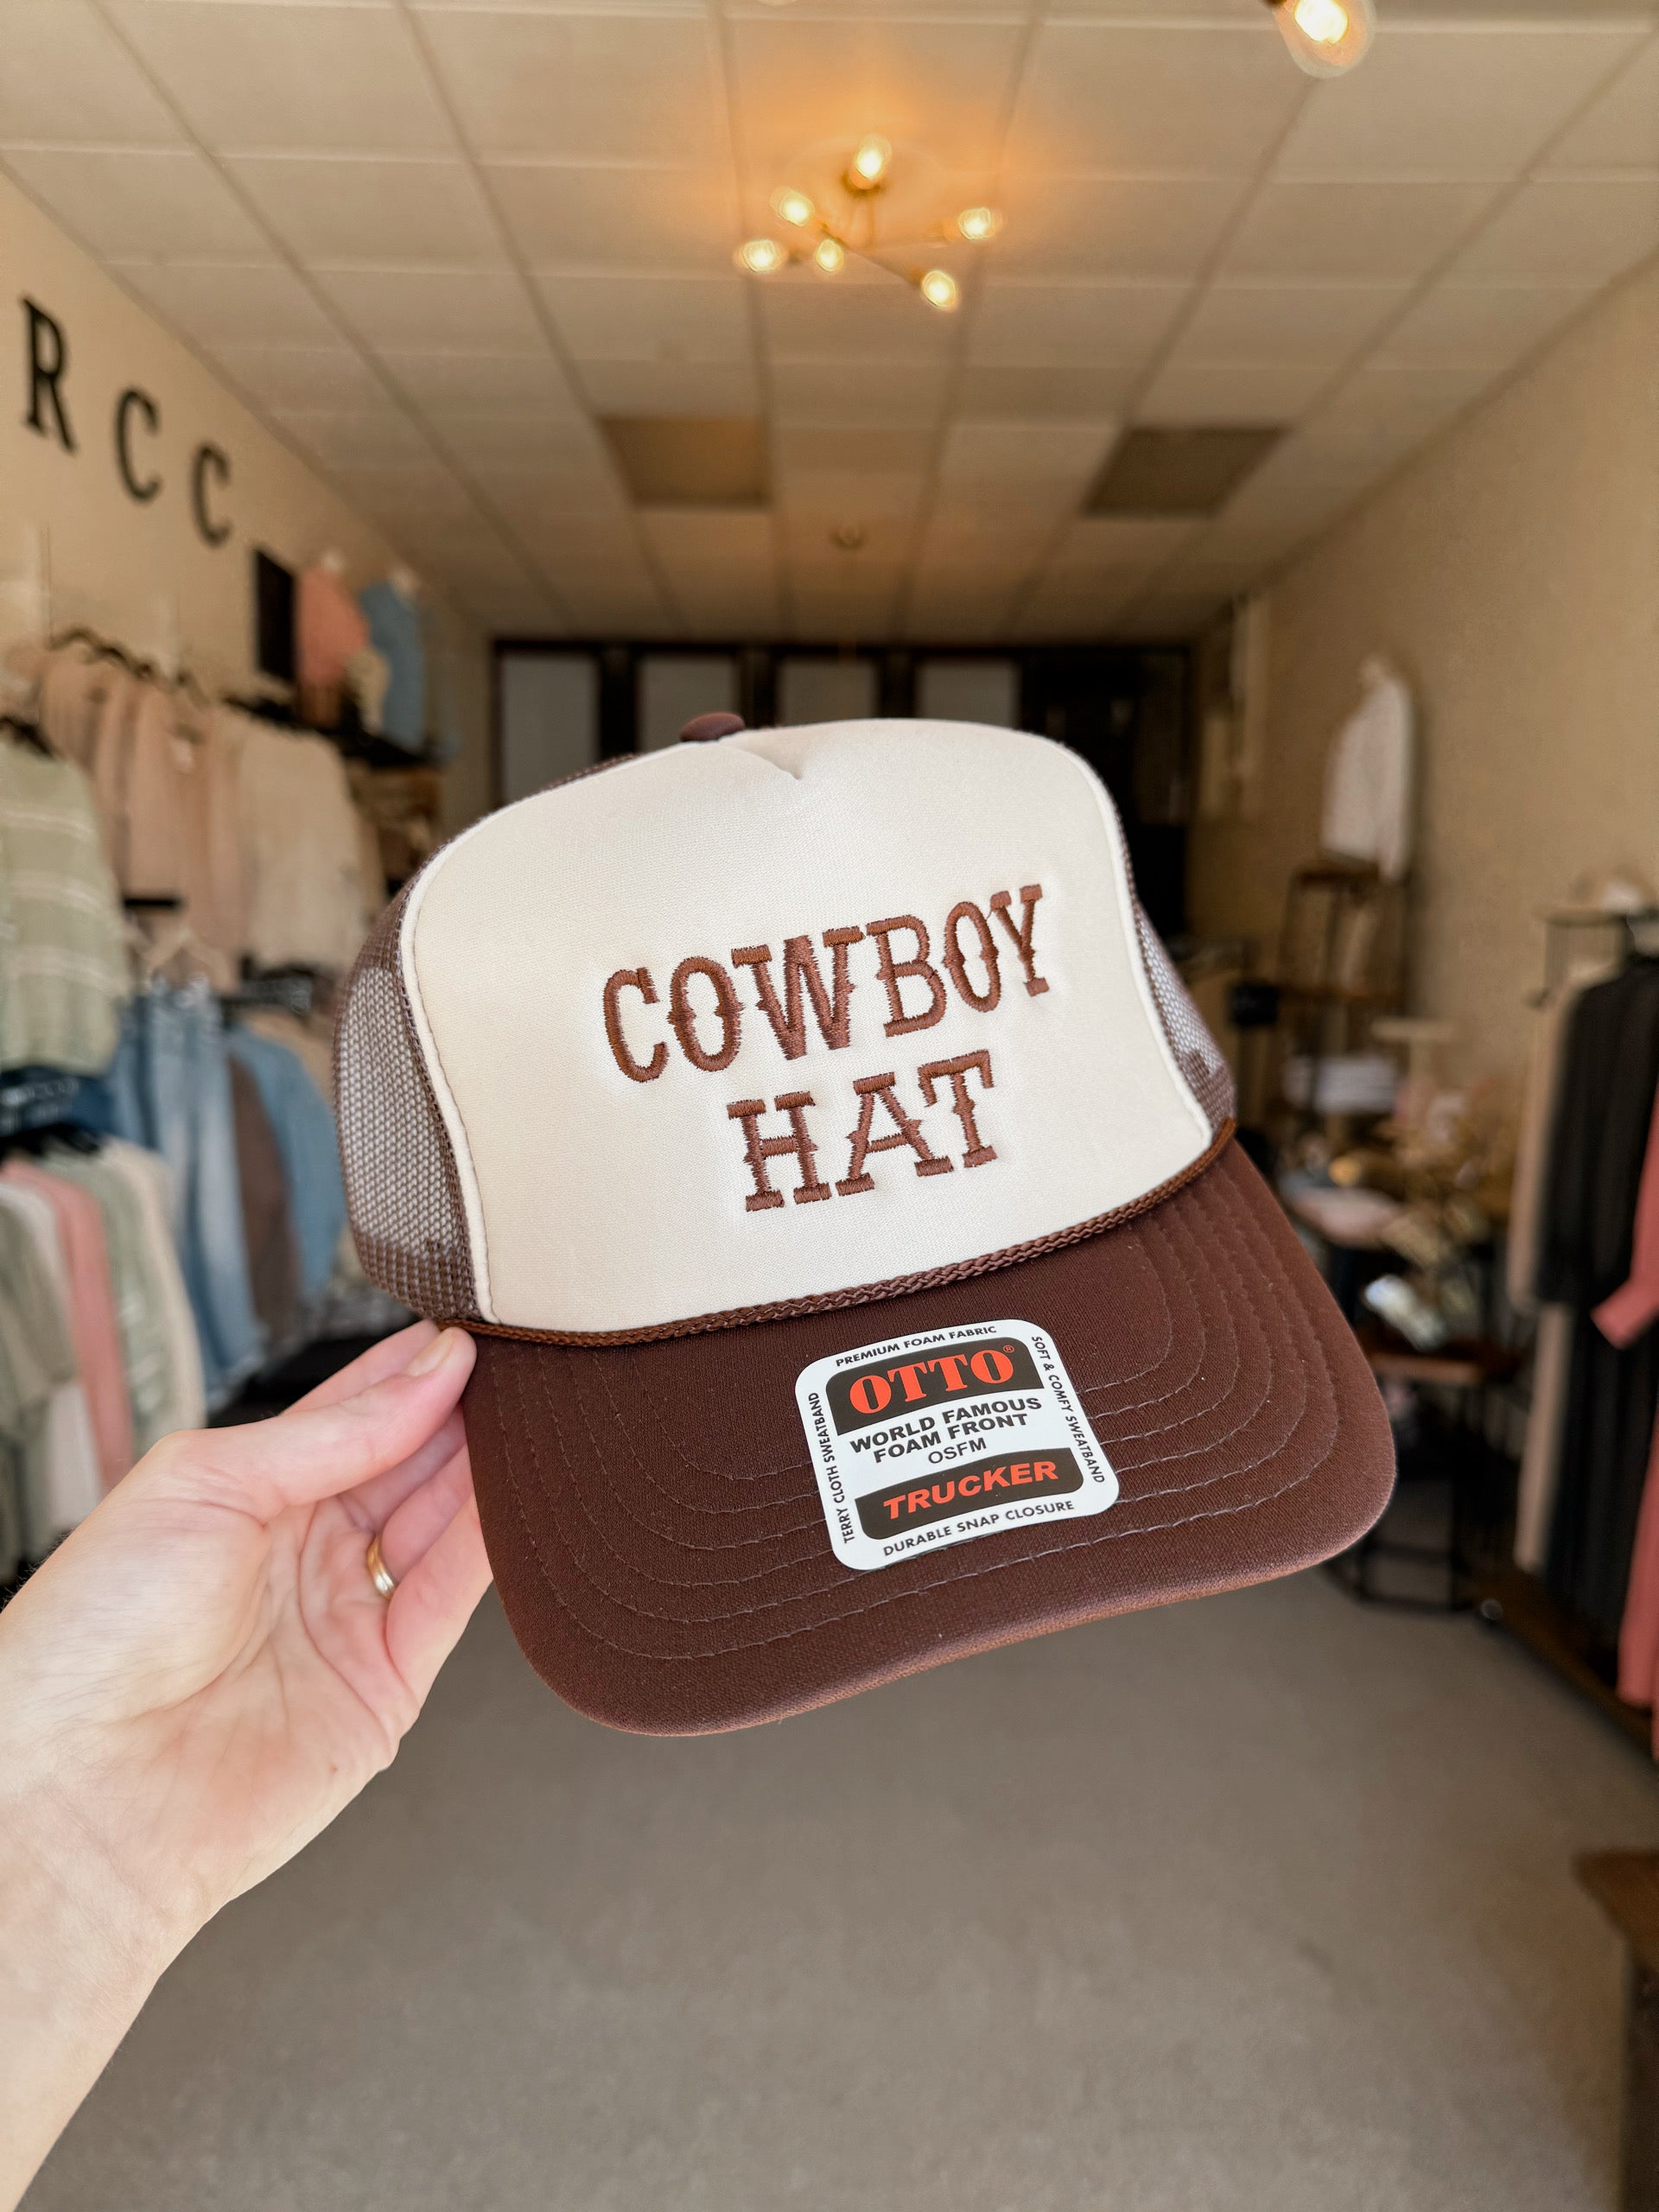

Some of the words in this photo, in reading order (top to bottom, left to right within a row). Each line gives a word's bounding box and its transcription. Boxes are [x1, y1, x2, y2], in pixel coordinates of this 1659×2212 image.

[603, 884, 1050, 1083] COWBOY
[727, 1049, 997, 1211] HAT
[836, 1343, 899, 1367] PREMIUM
[904, 1334, 945, 1348] FOAM
[950, 1325, 997, 1339] FABRIC
[1032, 1336, 1051, 1362] SOFT
[1044, 1363, 1054, 1371] &
[1048, 1375, 1073, 1413] COMFY
[808, 1392, 836, 1464] SWEATBAND
[850, 1416, 935, 1453] WORLD
[943, 1397, 1041, 1424] FAMOUS
[874, 1433, 942, 1463] FOAM
[949, 1414, 1027, 1439] FRONT
[1065, 1415, 1105, 1484] SWEATBAND
[928, 1438, 987, 1465] OSFM
[826, 1465, 845, 1503] CLOTH
[883, 1460, 1058, 1520] TRUCKER
[837, 1505, 855, 1543] TERRY
[883, 1525, 951, 1556] DURABLE
[957, 1513, 999, 1533] SNAP
[1005, 1501, 1074, 1521] CLOSURE
